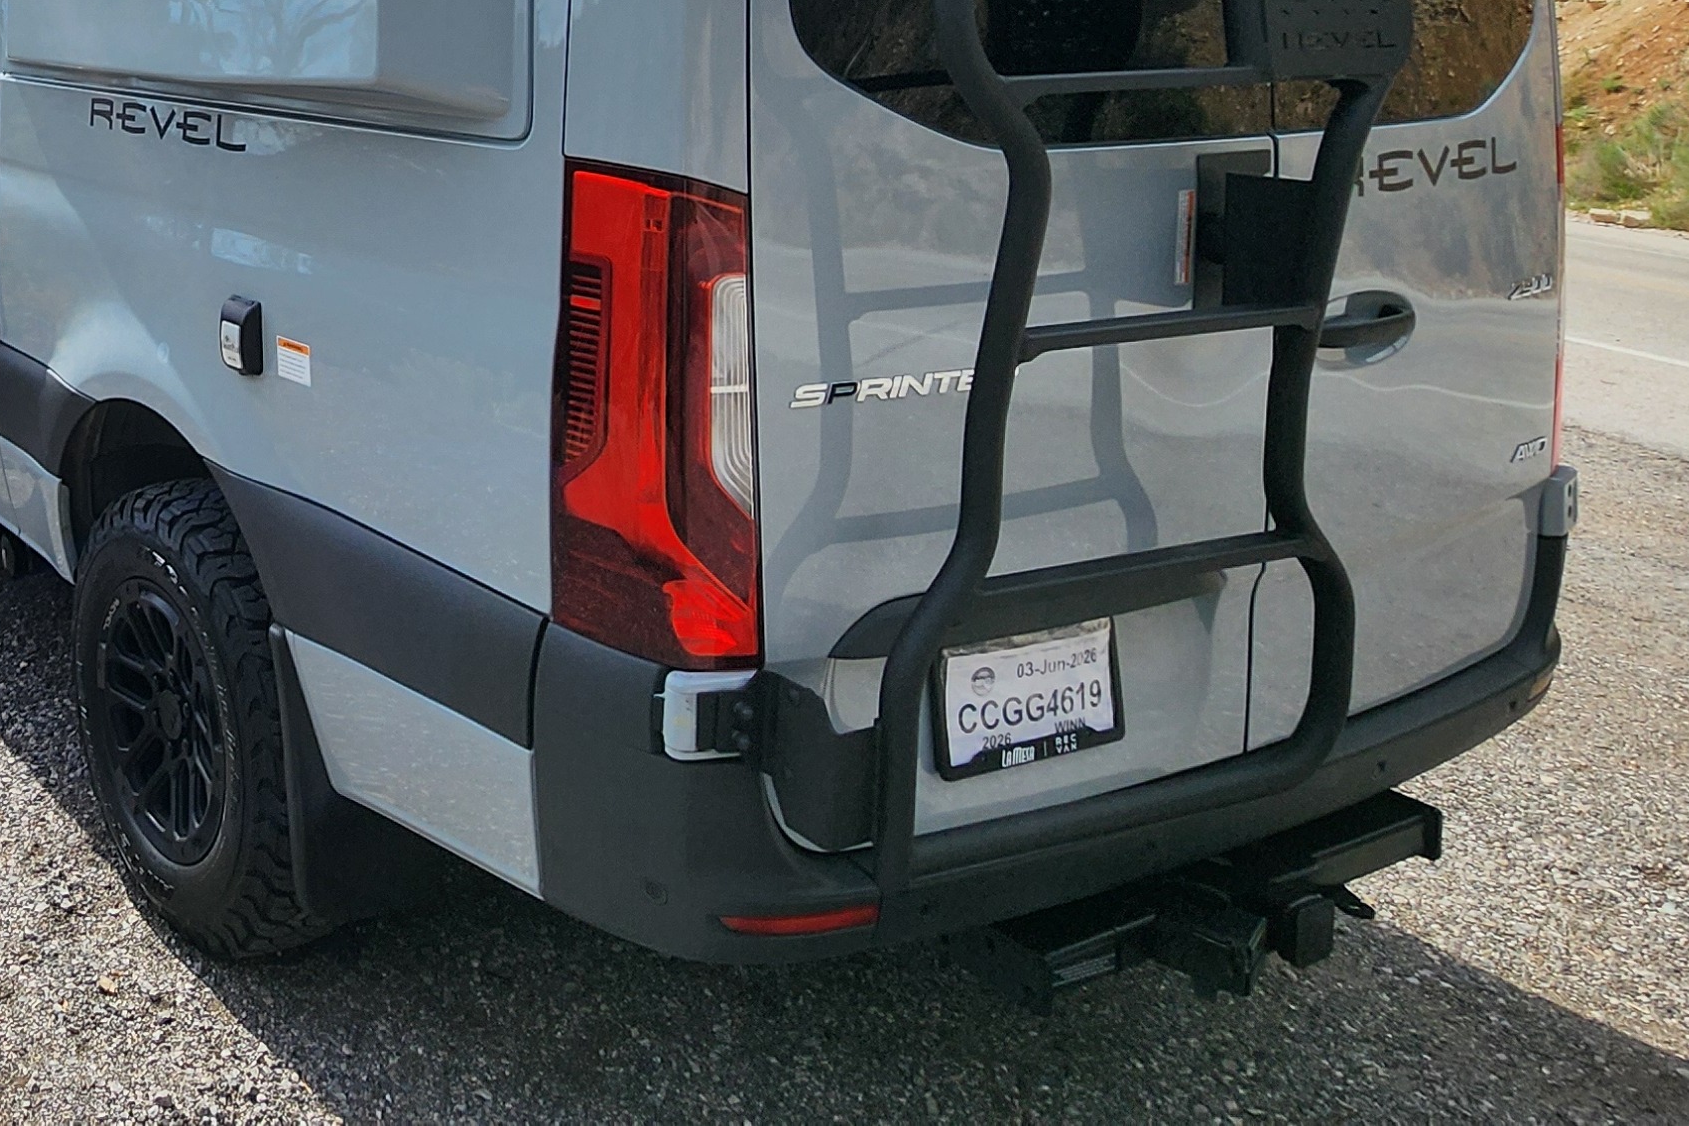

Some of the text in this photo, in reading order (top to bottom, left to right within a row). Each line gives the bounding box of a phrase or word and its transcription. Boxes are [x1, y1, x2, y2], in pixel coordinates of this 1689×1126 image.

[89, 97, 246, 152] REVEL
[789, 368, 975, 409] SPRINTE
[958, 679, 1102, 734] CCGG4619
[982, 732, 1012, 751] 2026
